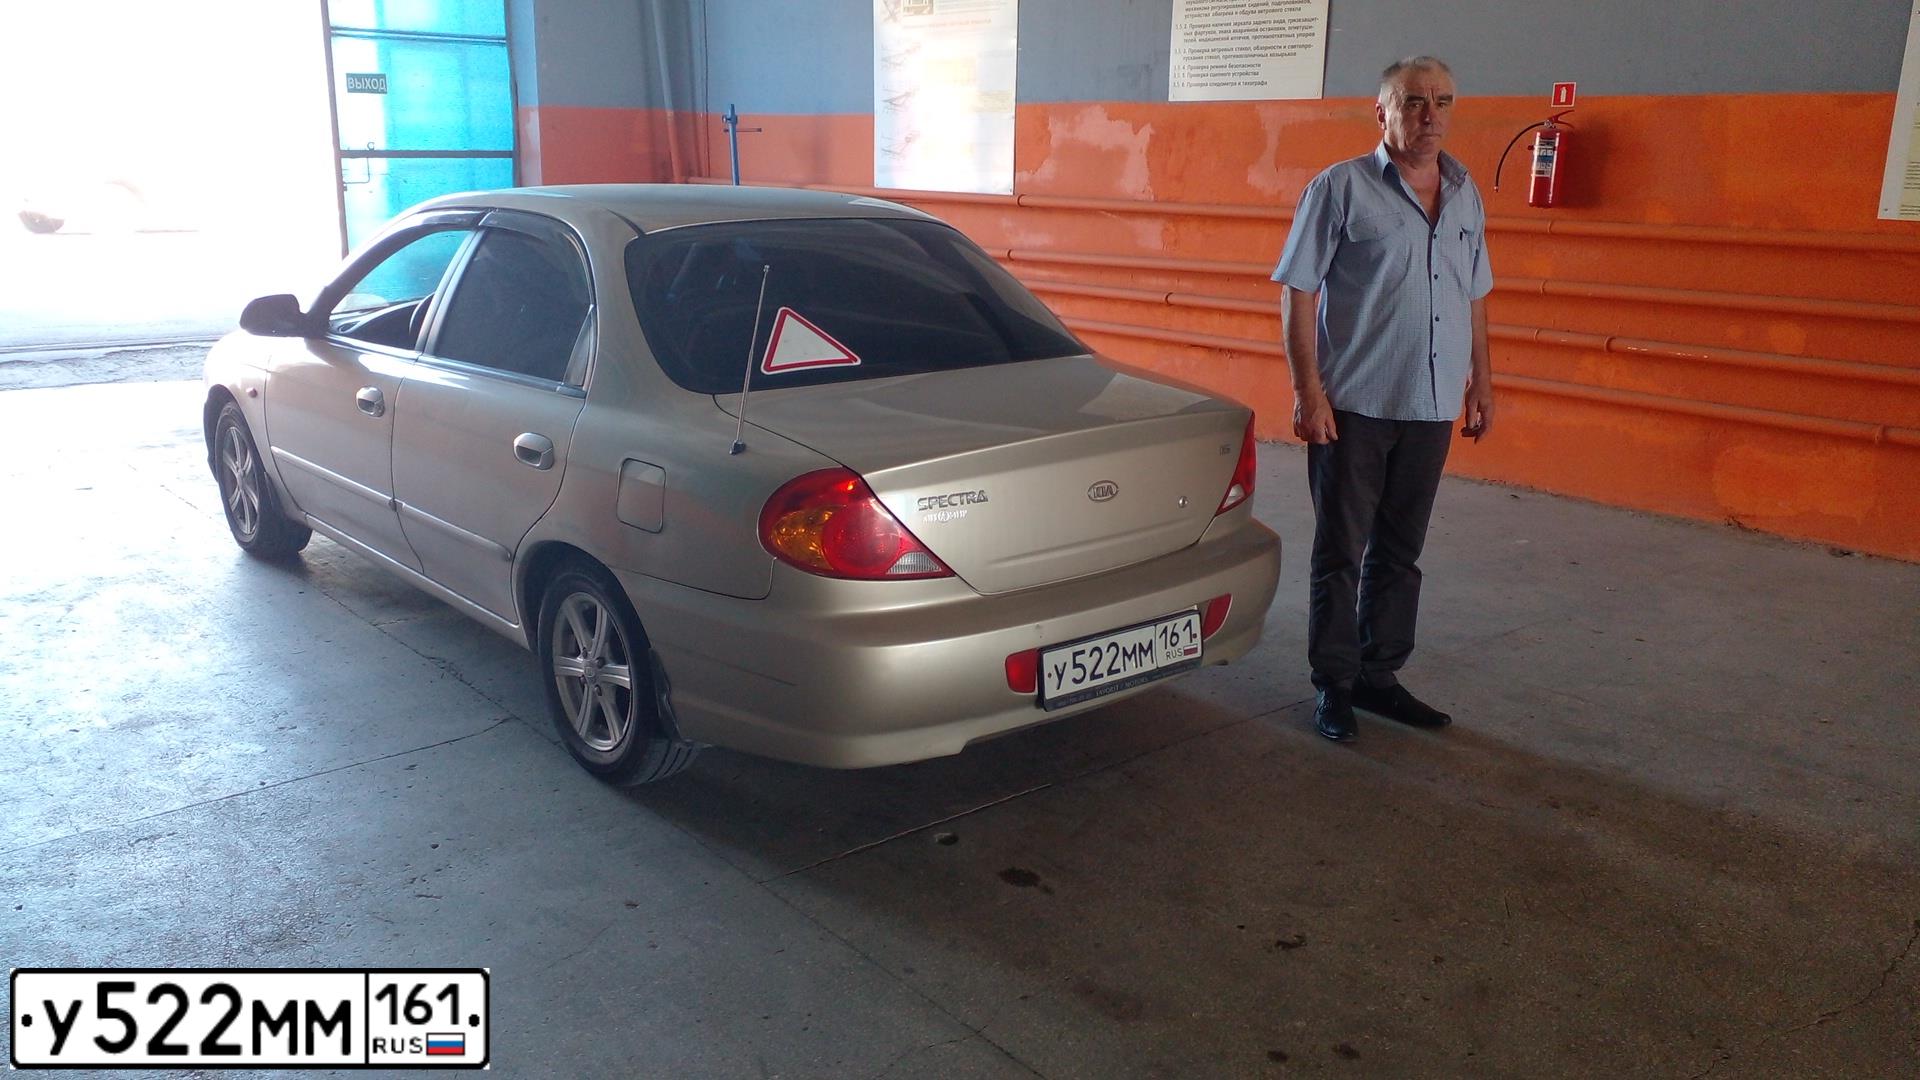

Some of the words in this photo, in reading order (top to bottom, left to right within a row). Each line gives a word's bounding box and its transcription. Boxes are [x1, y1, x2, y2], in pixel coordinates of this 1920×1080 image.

[348, 77, 386, 92] ВЫХОД
[917, 489, 988, 511] SPECTRA
[1158, 619, 1194, 650] 161
[1165, 650, 1184, 661] RUS
